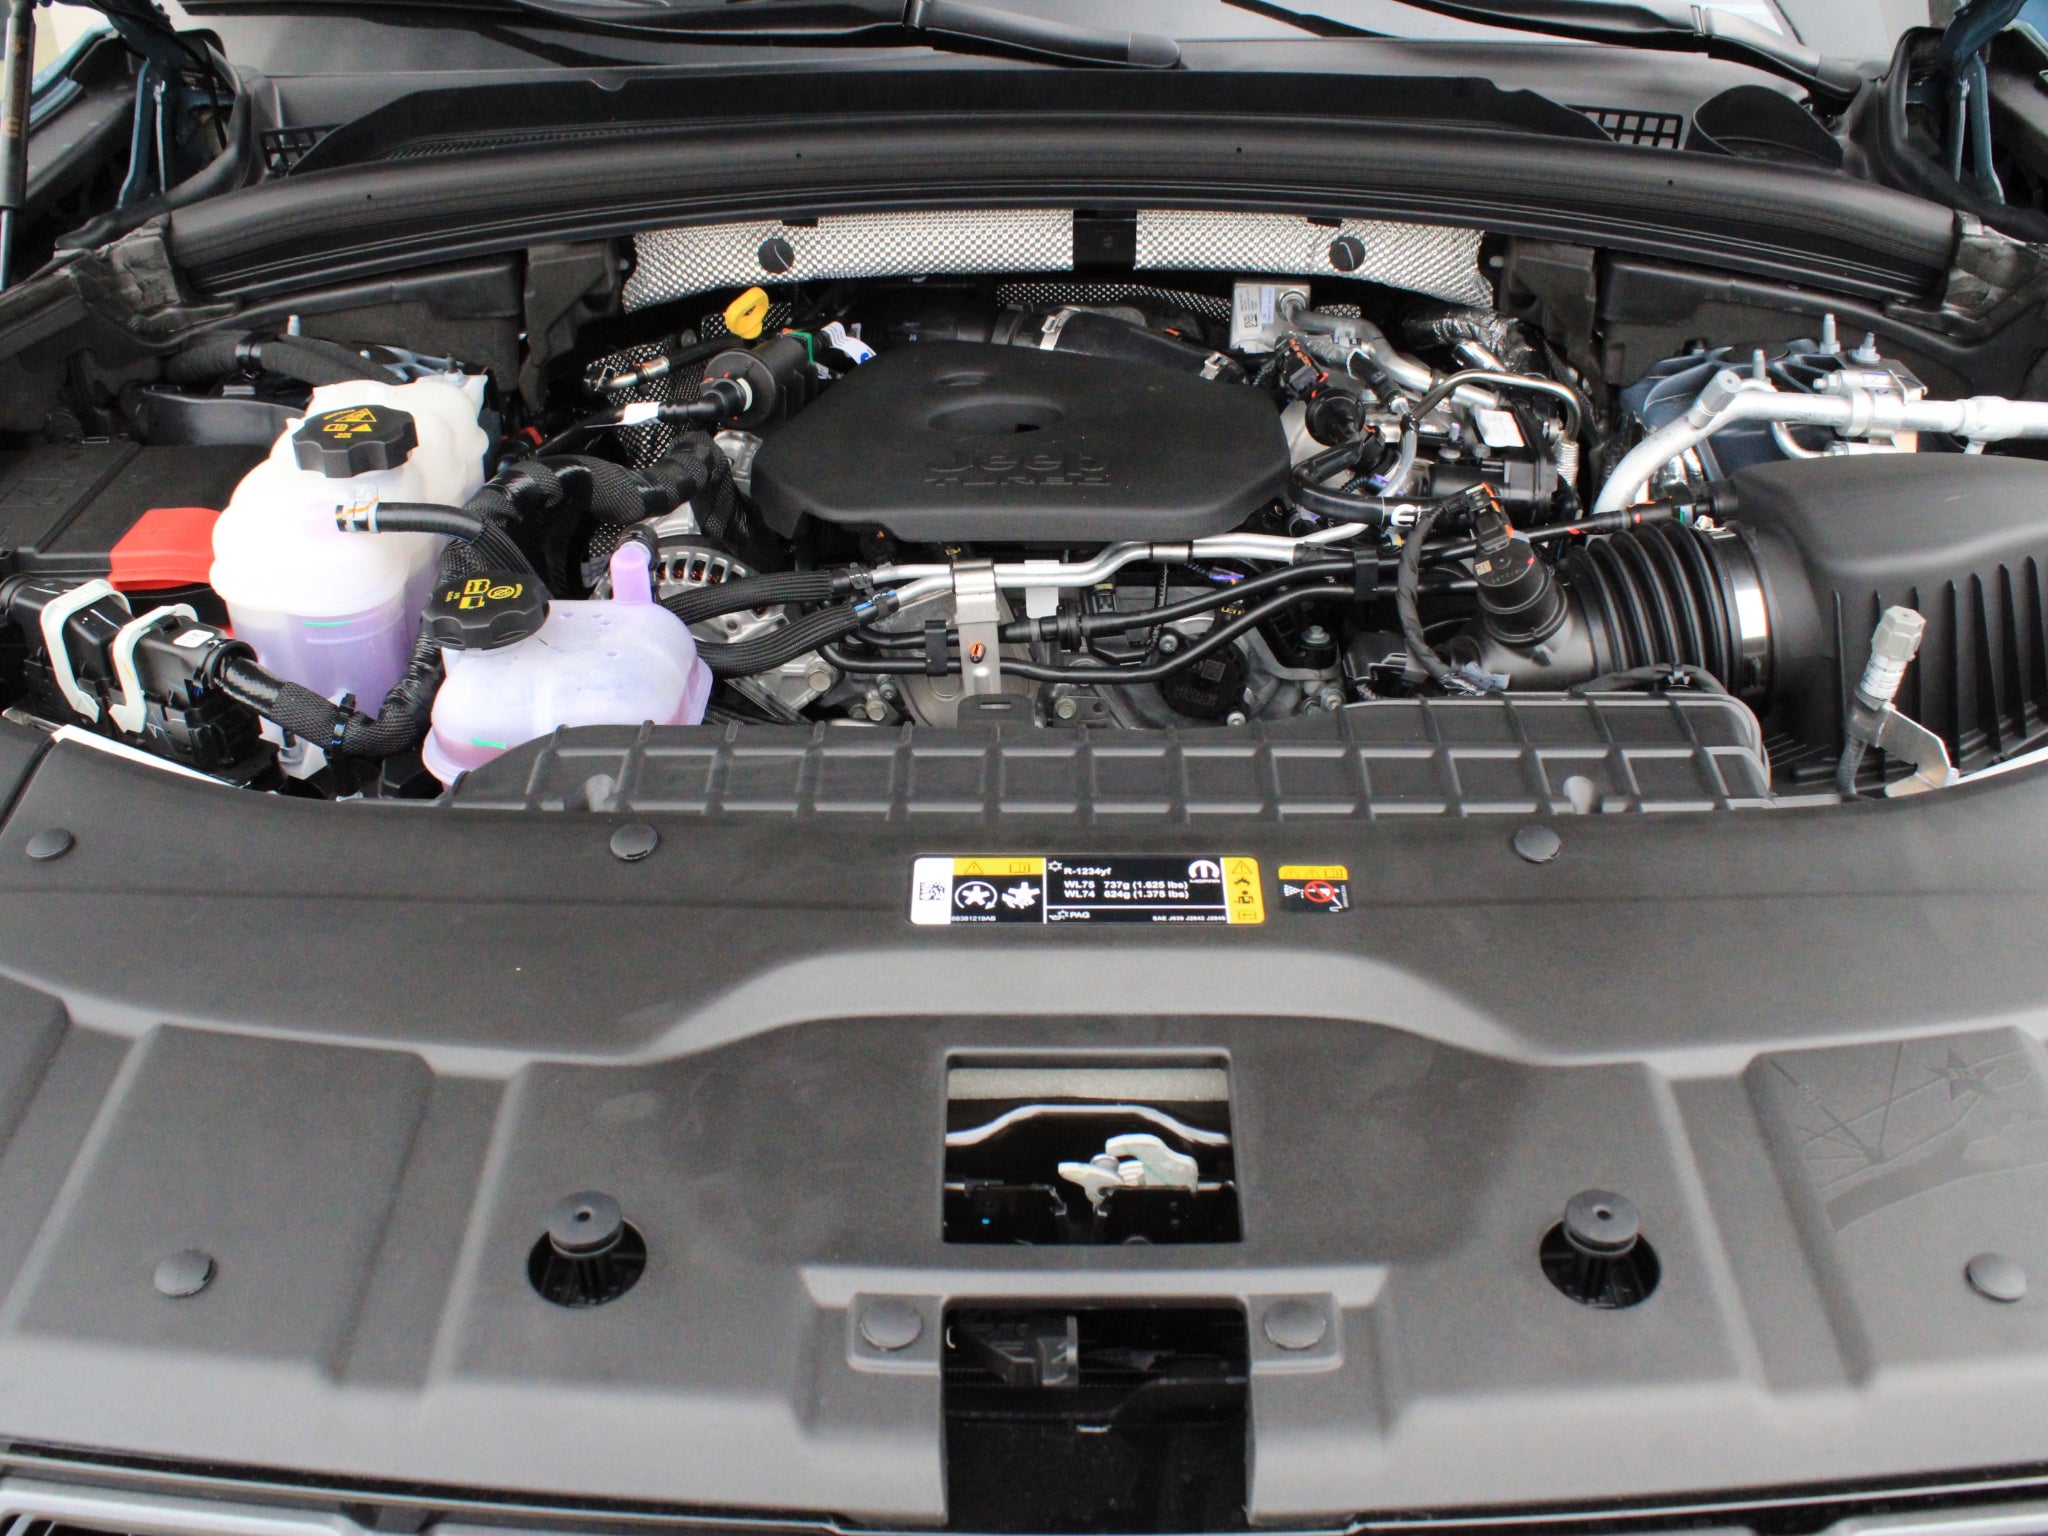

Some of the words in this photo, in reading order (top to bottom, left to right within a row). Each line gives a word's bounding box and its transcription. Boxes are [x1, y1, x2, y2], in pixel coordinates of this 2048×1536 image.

[1063, 867, 1112, 877] R-1234yf
[1064, 880, 1095, 889] WL75
[1103, 881, 1130, 890] 737g
[1168, 880, 1189, 890] lbs)
[1064, 890, 1096, 899] WL74
[1103, 890, 1131, 900] 624g
[1133, 890, 1166, 900] (1.375
[1168, 890, 1189, 900] lbs)
[1070, 911, 1090, 919] PAG
